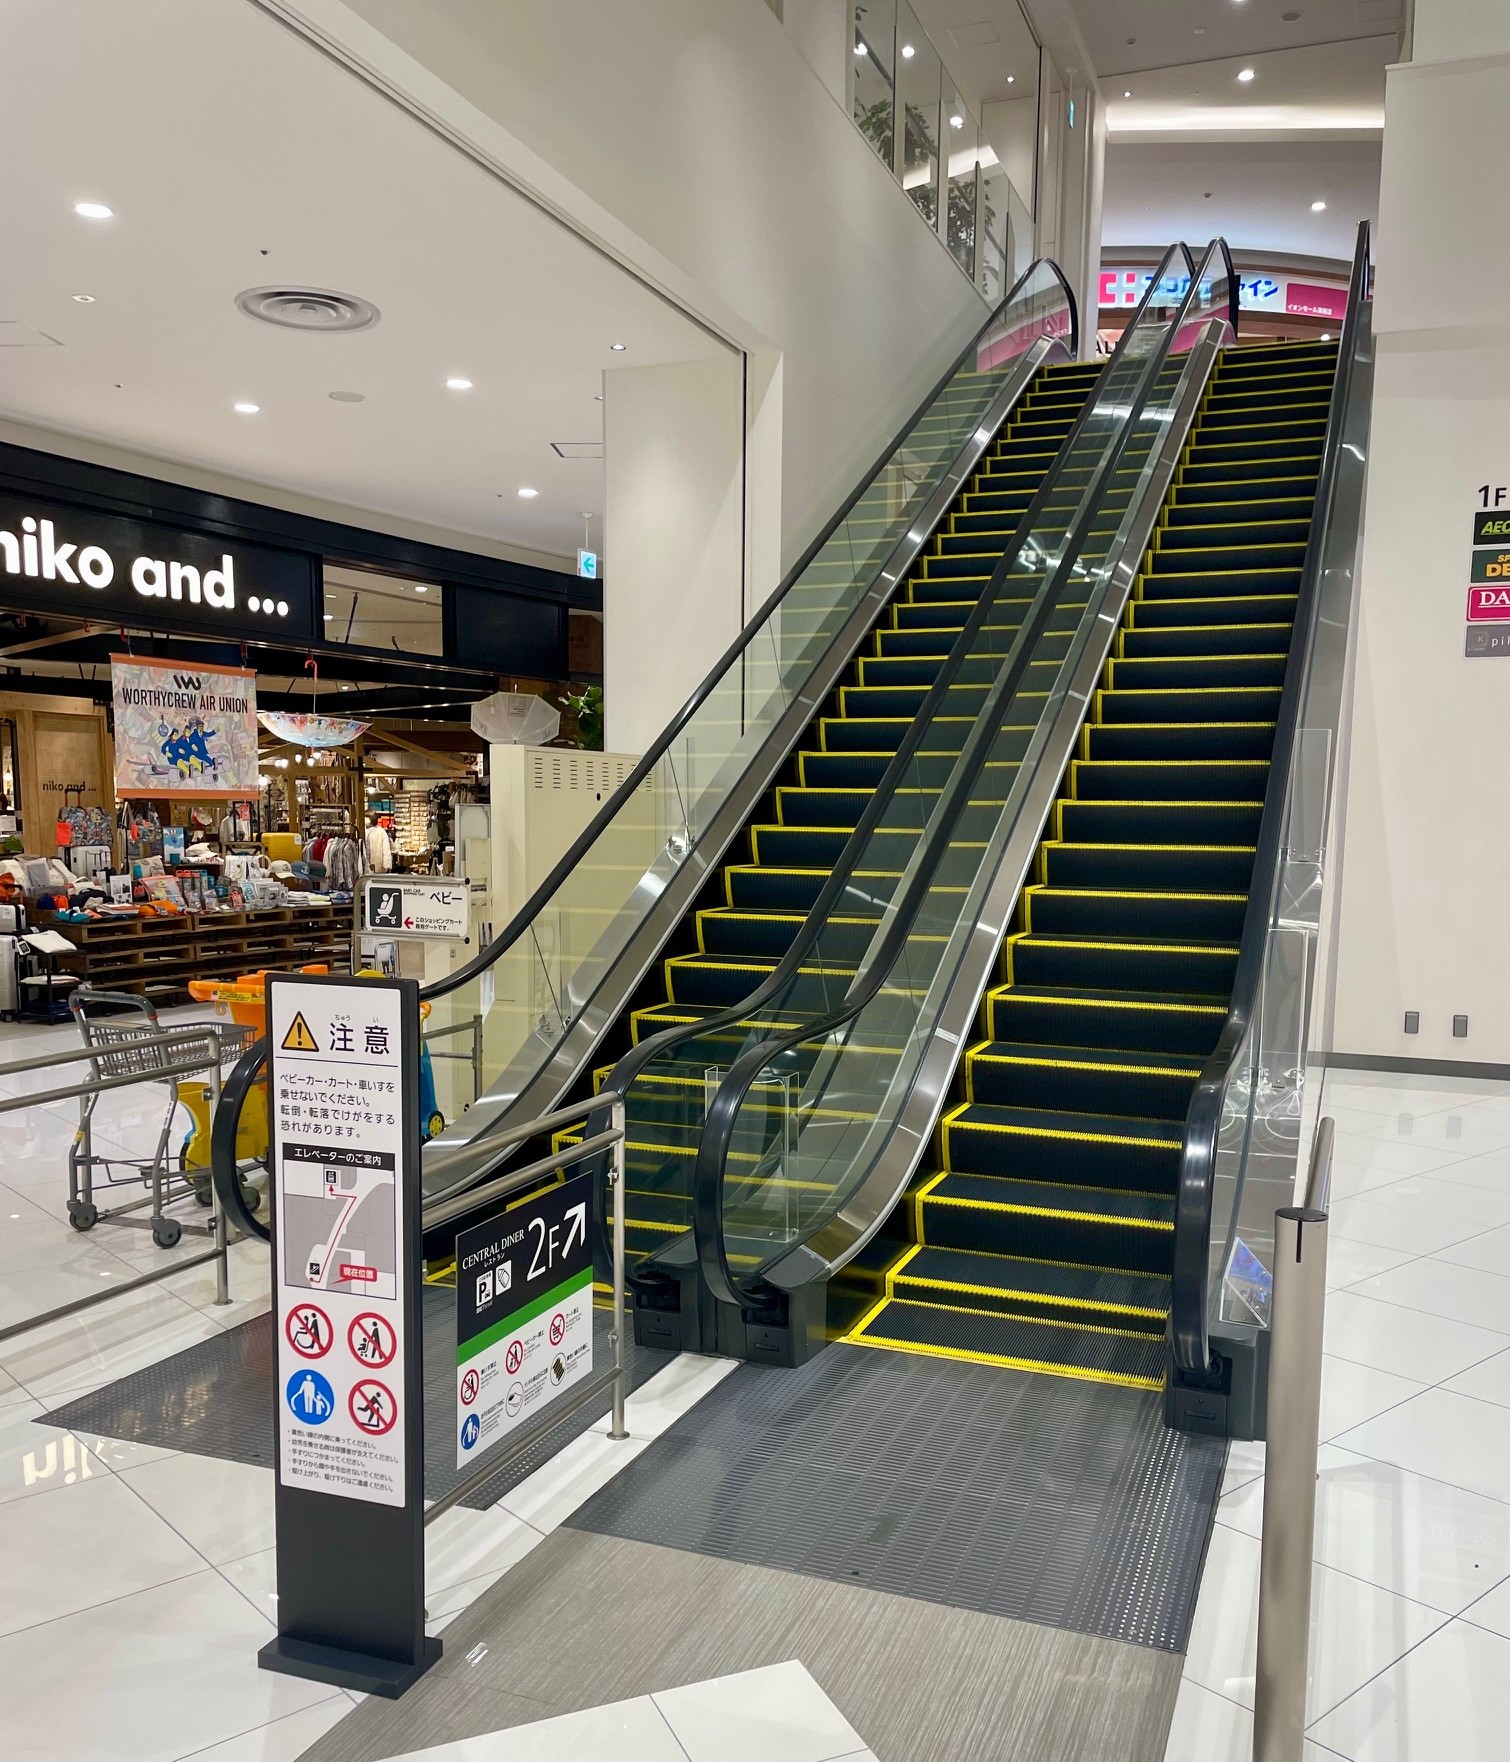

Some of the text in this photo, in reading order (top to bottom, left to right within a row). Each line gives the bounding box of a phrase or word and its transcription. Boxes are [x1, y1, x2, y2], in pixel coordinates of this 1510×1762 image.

[1478, 485, 1507, 507] 1F
[131, 554, 235, 609] and
[122, 687, 248, 713] WORTHYCREW AIR UNION
[42, 780, 64, 791] niko
[430, 891, 463, 905] ベビー
[329, 1022, 390, 1055] 注意
[280, 1073, 395, 1093] ベビーカー・カート・車いすを
[280, 1088, 370, 1107] 乗せないでください。
[280, 1105, 395, 1125] 転倒・転落でけがをする
[281, 1120, 360, 1138] 恐れがあります。
[294, 1148, 382, 1166] エレベーターのご案内
[462, 1229, 525, 1270] CENTRAL DINER
[526, 1217, 560, 1282] 2F
[484, 1252, 506, 1268] レストラン
[343, 1266, 374, 1280] 現在位置
